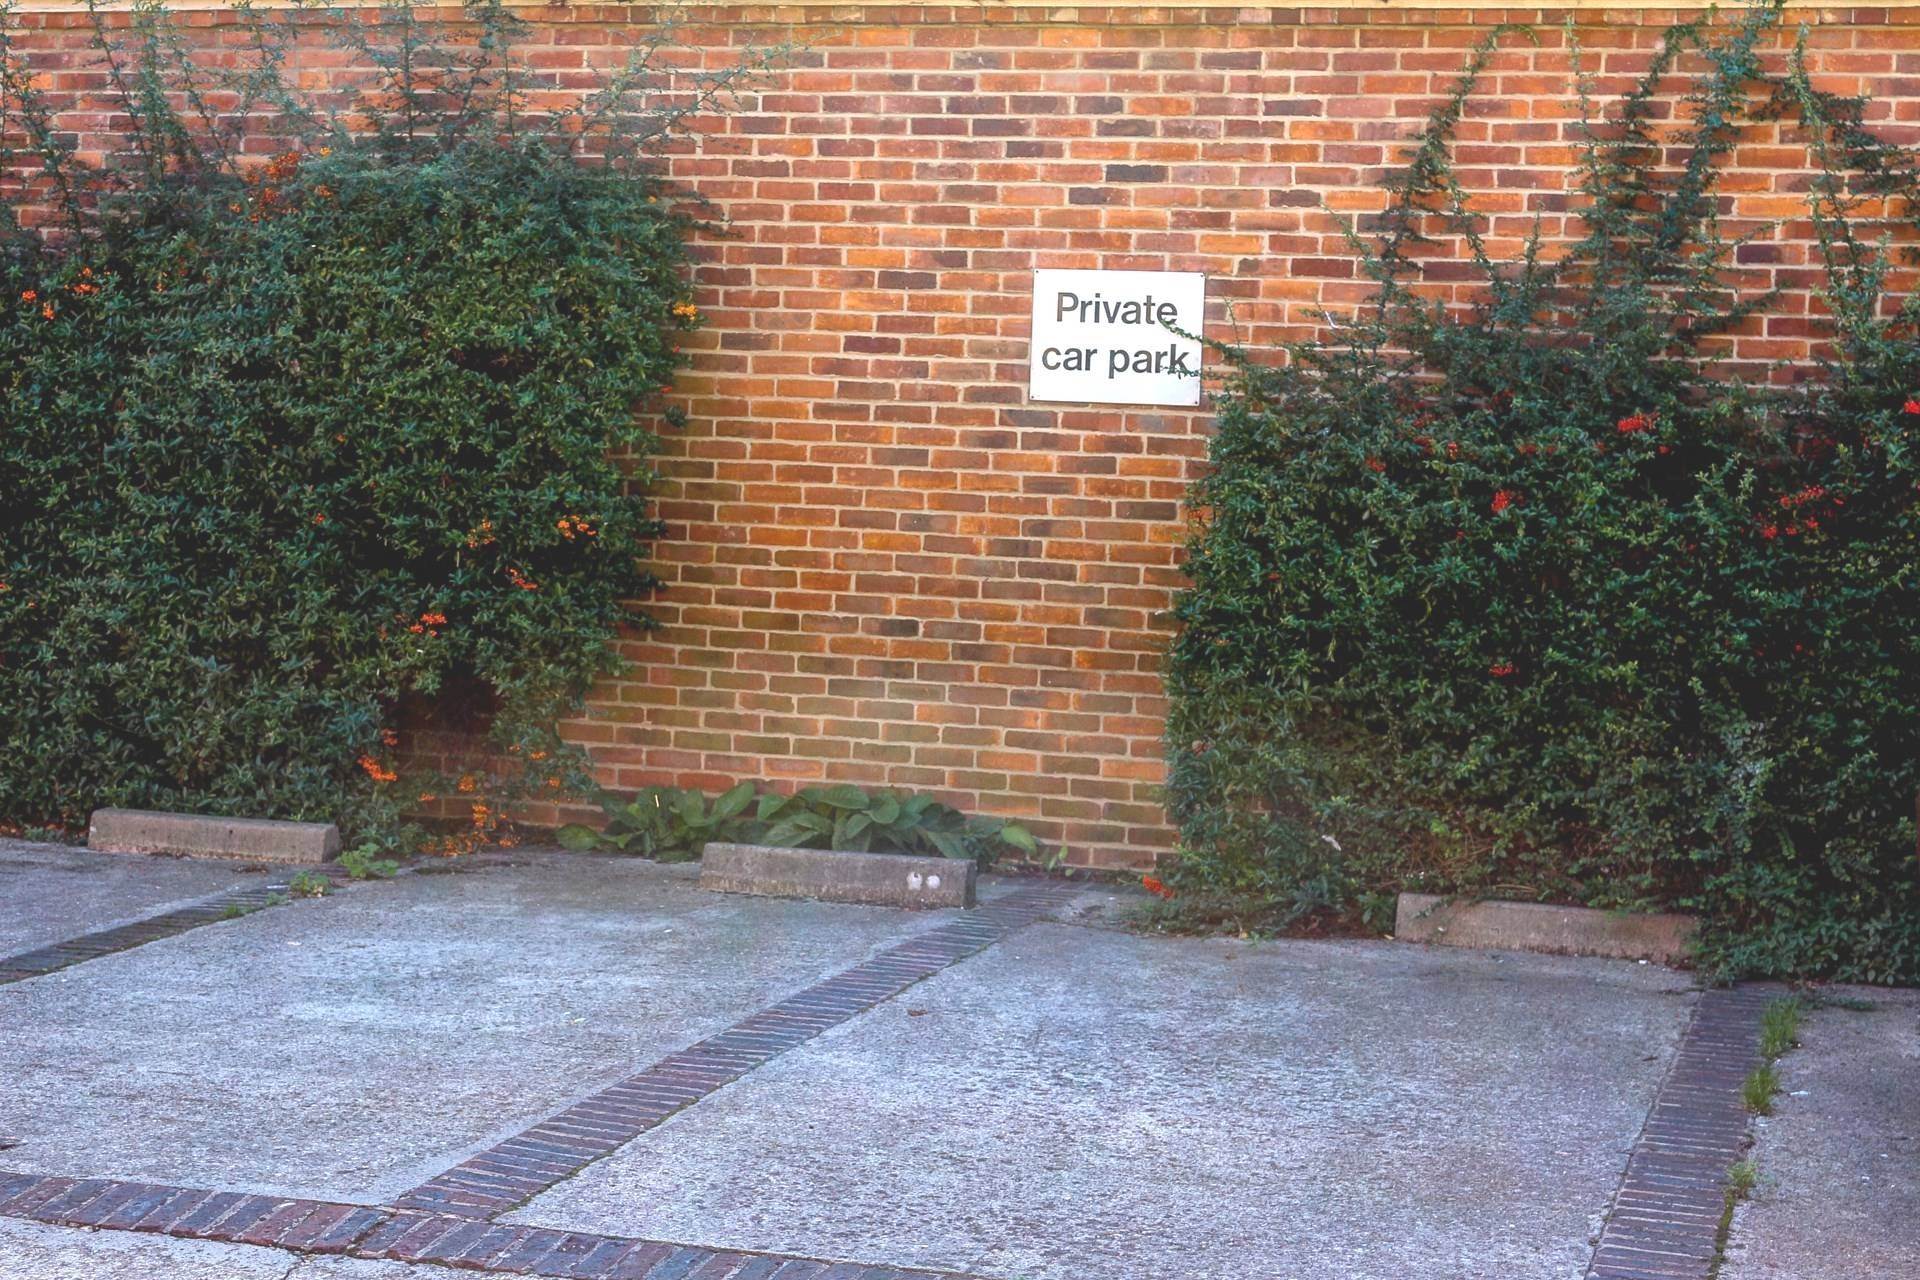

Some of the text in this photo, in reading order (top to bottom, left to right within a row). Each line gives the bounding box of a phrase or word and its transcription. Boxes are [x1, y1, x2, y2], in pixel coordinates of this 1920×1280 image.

[1056, 292, 1178, 325] Private
[1042, 343, 1190, 379] car park
